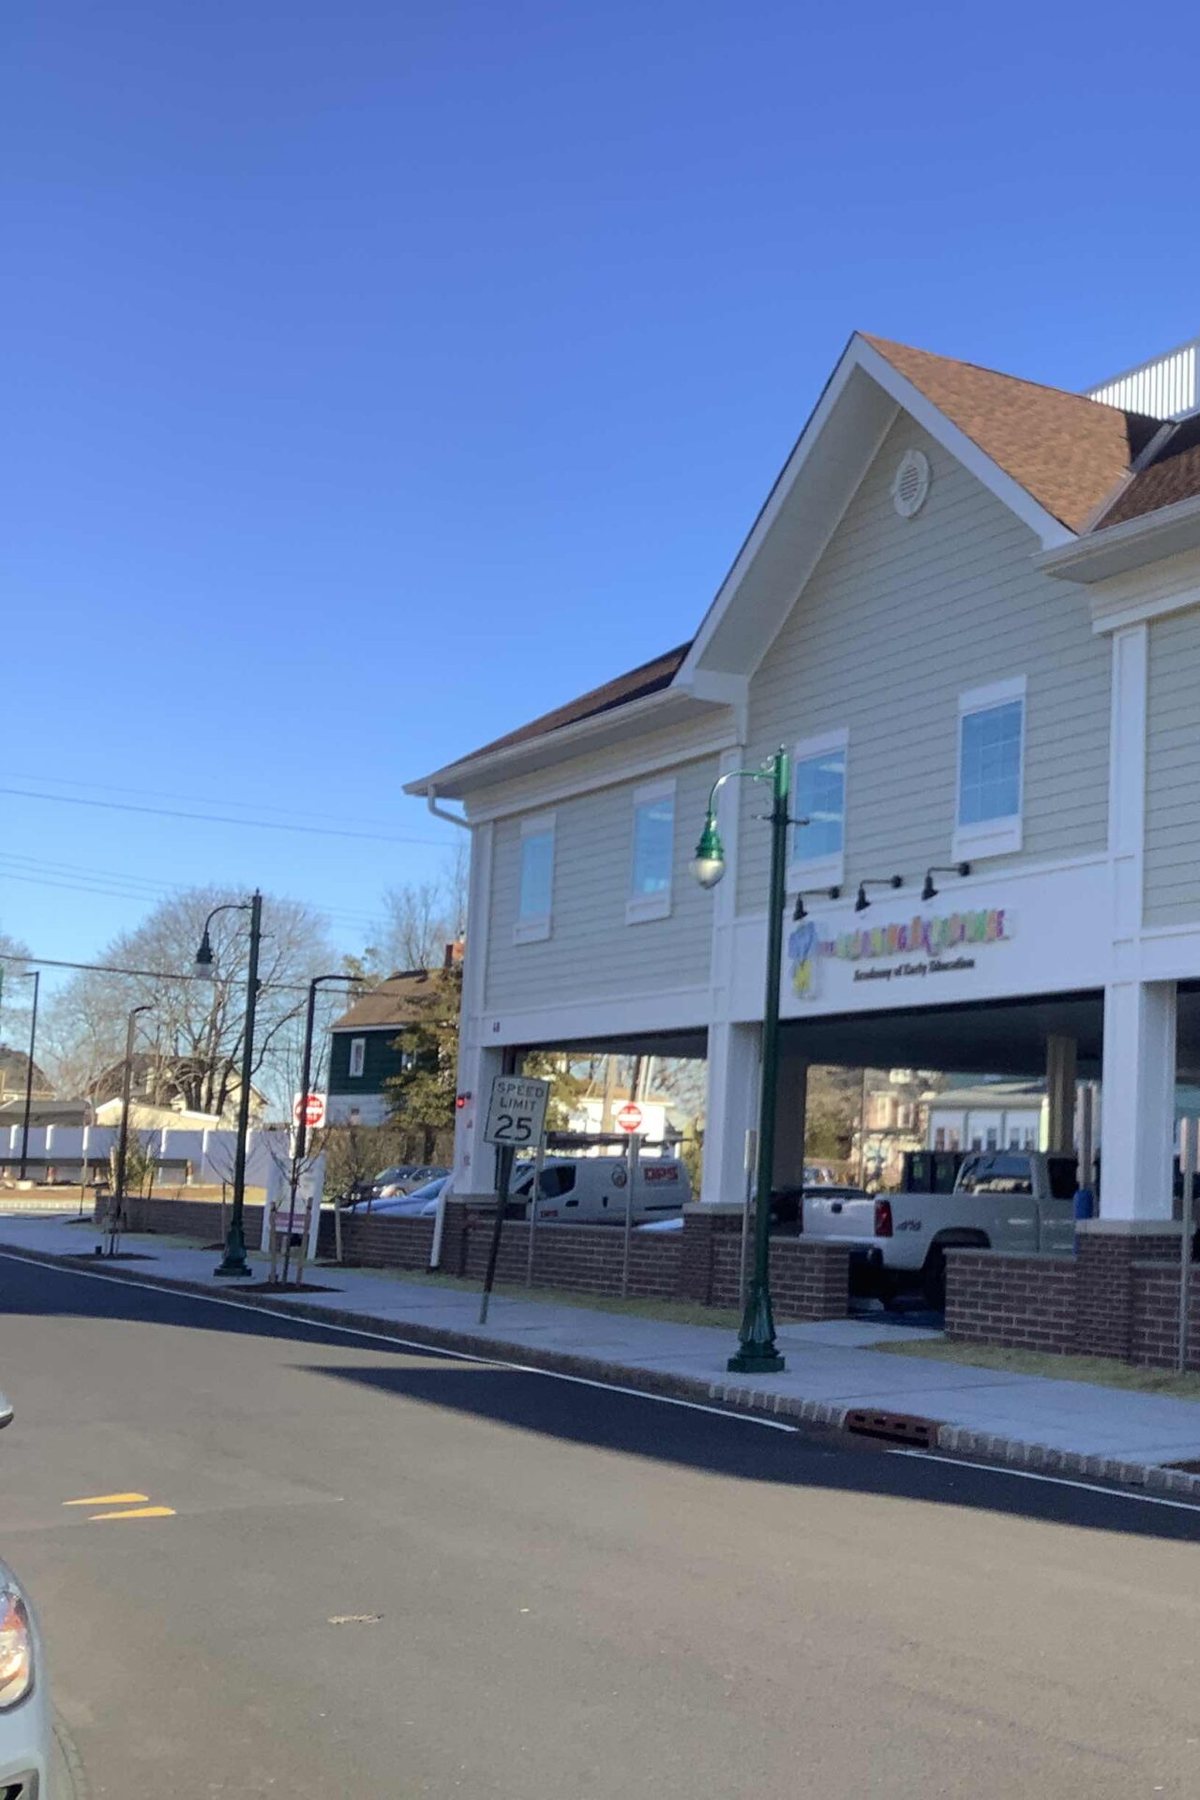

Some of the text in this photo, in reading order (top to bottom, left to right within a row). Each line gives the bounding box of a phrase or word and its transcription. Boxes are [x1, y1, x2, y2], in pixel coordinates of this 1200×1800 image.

[497, 1082, 544, 1098] SPEED
[500, 1097, 536, 1111] LIMIT
[494, 1115, 532, 1141] 25
